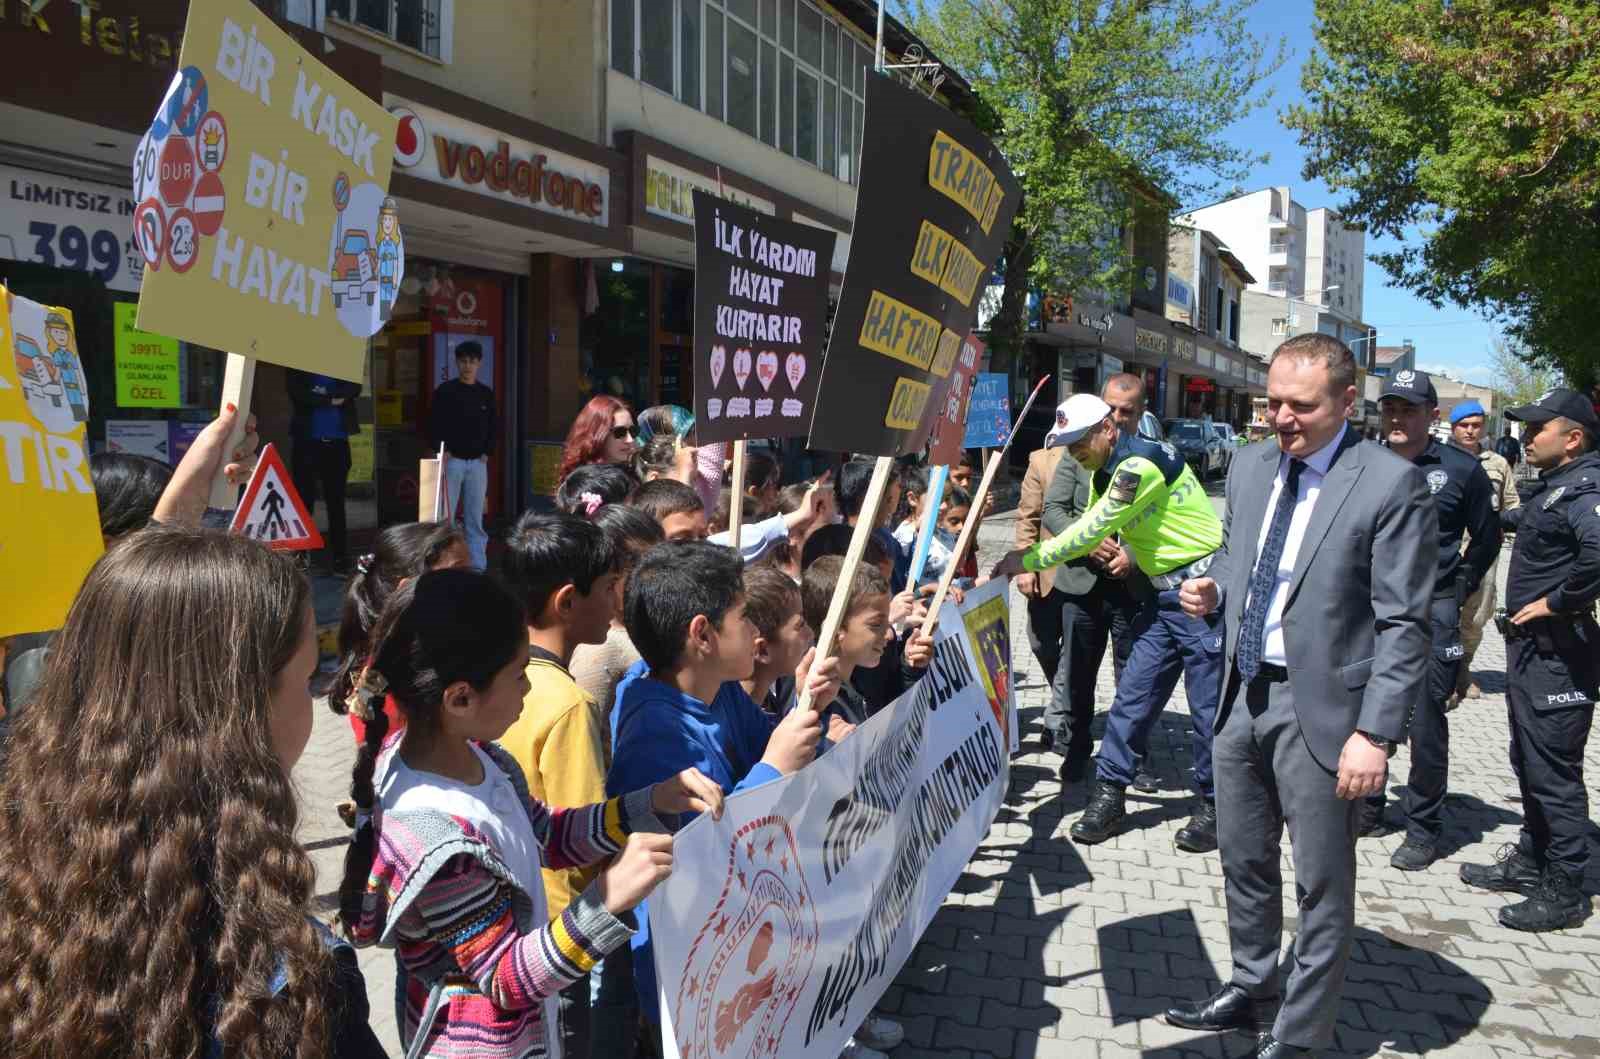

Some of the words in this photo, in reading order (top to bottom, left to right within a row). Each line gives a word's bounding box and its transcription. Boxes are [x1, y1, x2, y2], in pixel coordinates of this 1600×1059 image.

[216, 16, 276, 106] BİR
[291, 69, 382, 176] KASK
[245, 149, 308, 225] BİR
[433, 133, 602, 217] vodafone
[211, 227, 332, 316] HAYAT
[714, 207, 744, 258] İLK
[749, 228, 817, 277] YARDIM
[716, 304, 802, 344] KURTARIR
[729, 265, 784, 306] HAYAT
